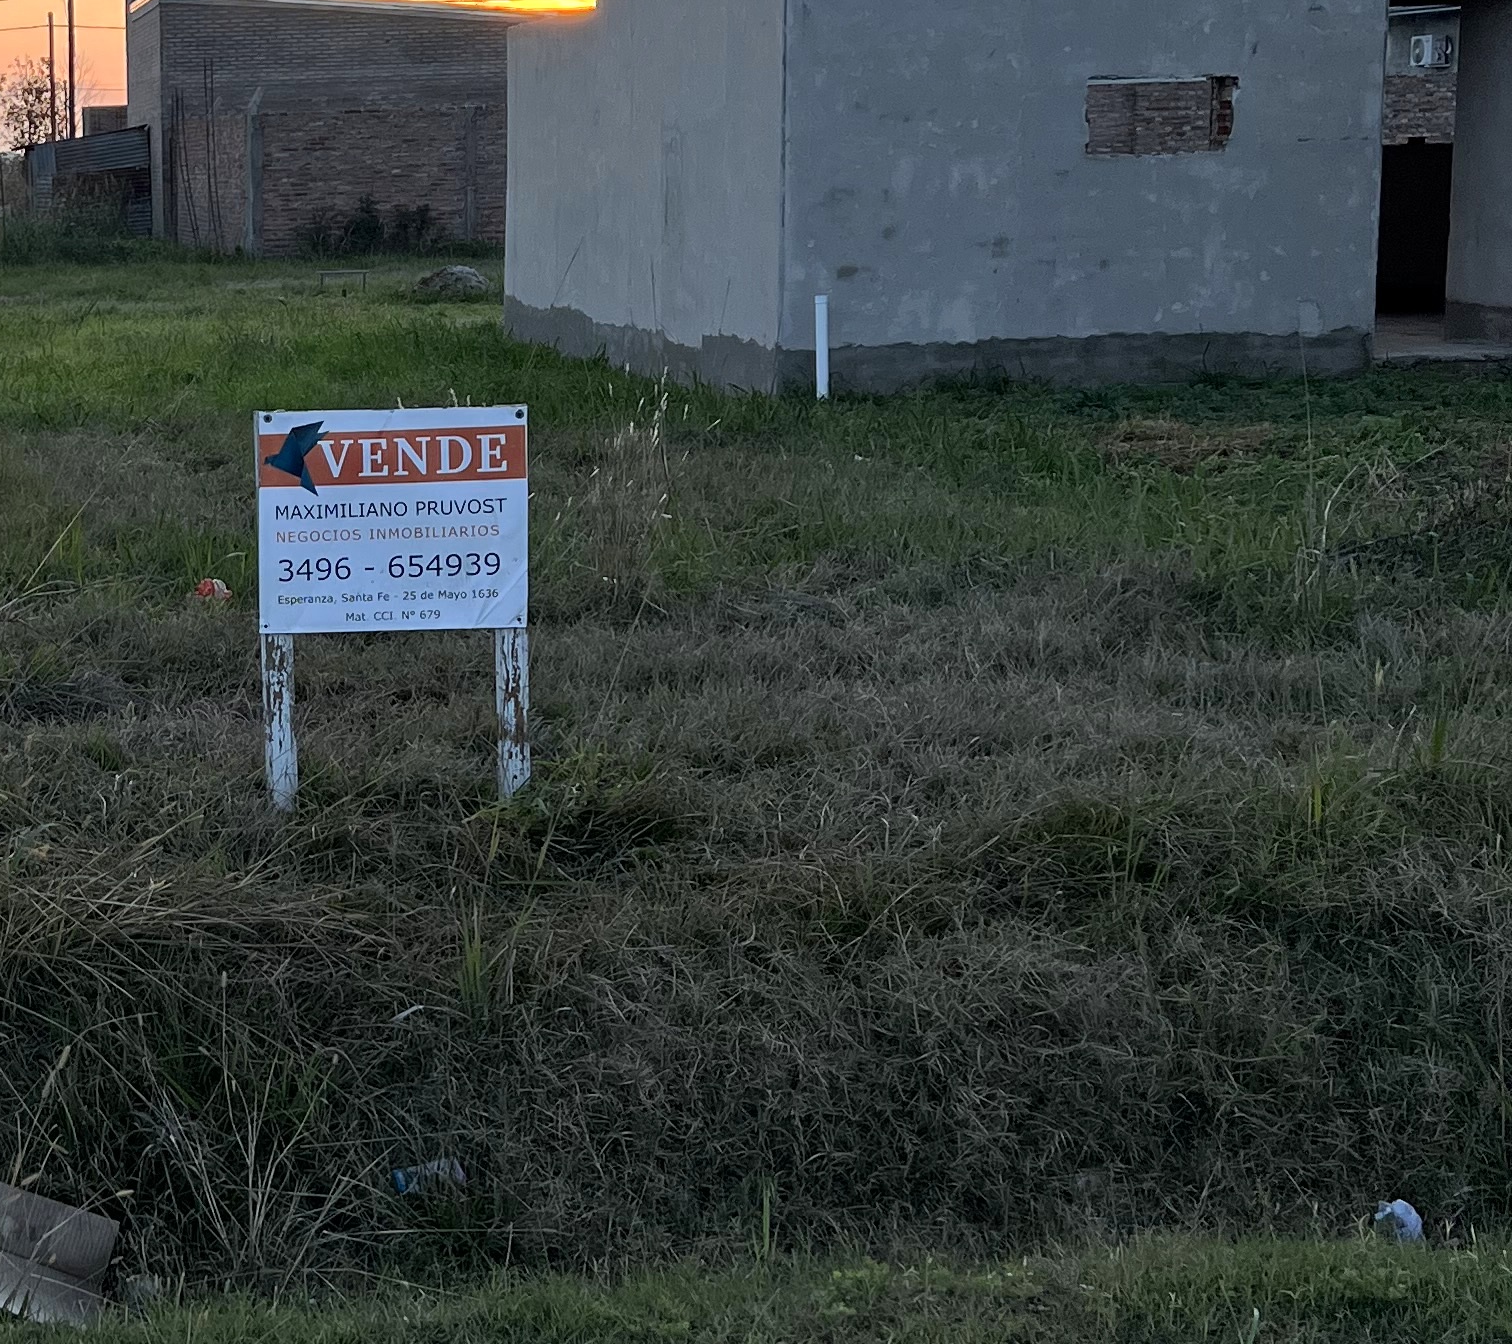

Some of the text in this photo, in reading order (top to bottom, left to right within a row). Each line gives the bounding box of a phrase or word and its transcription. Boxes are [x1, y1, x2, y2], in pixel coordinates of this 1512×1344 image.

[317, 433, 508, 478] VENDE
[275, 497, 508, 520] MAXIMILIANO PRUVOST
[276, 524, 500, 543] NEGOCIOS INMOBILIARIOS
[278, 557, 352, 582] 3496
[388, 552, 501, 578] 654939
[277, 595, 337, 606] Esperanza,
[341, 592, 373, 602] Santa
[377, 591, 390, 602] Fe
[402, 590, 417, 600] 25
[420, 590, 434, 600] de
[438, 589, 467, 601] Mayo
[471, 588, 499, 599] 1636
[419, 609, 441, 620] 679
